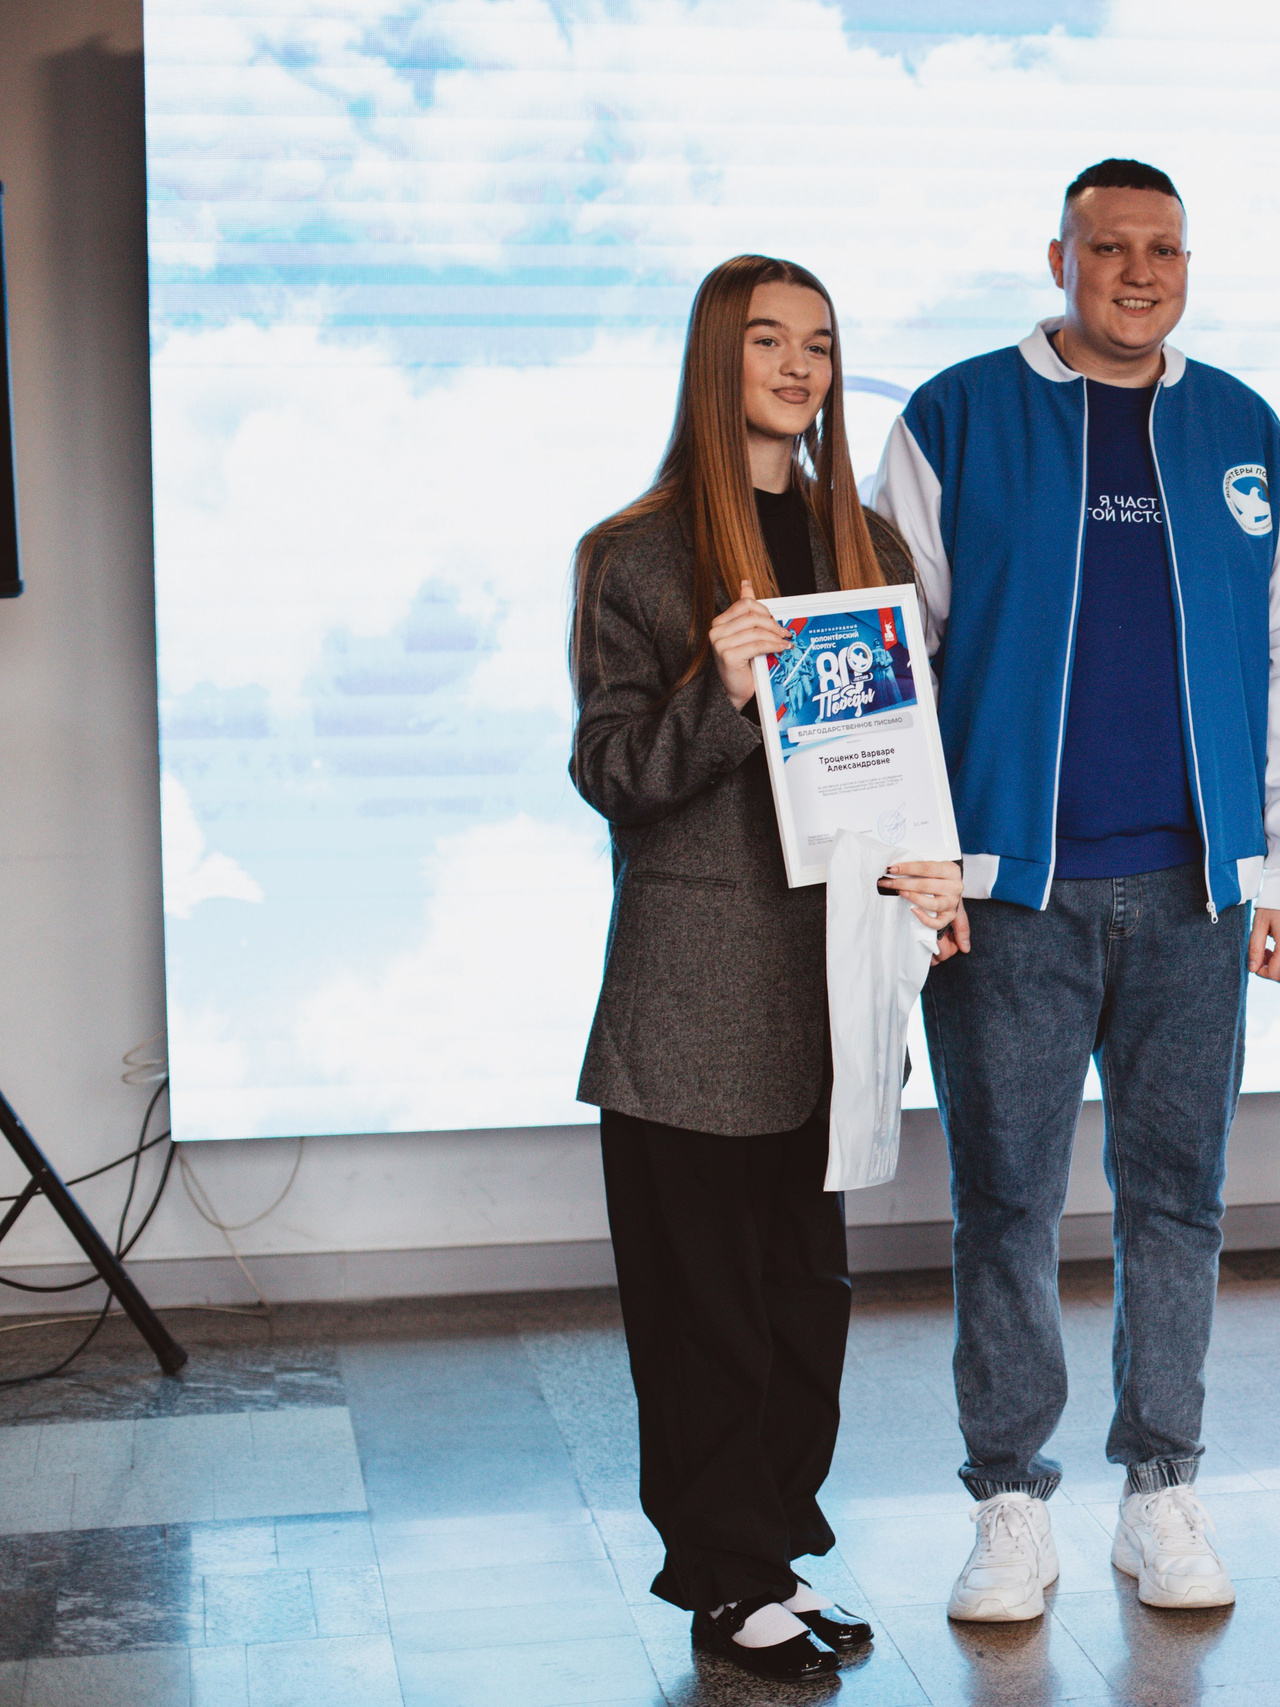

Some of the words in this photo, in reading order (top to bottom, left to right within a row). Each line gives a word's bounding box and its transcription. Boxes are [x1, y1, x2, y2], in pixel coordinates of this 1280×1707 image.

[1099, 495, 1110, 507] Я
[798, 721, 873, 737] БЛАГОДАРСТВЕННОЕ
[874, 717, 903, 726] ПИСЬМО
[818, 752, 859, 766] Троценко
[861, 747, 895, 760] Варваре
[827, 756, 891, 773] Александровне
